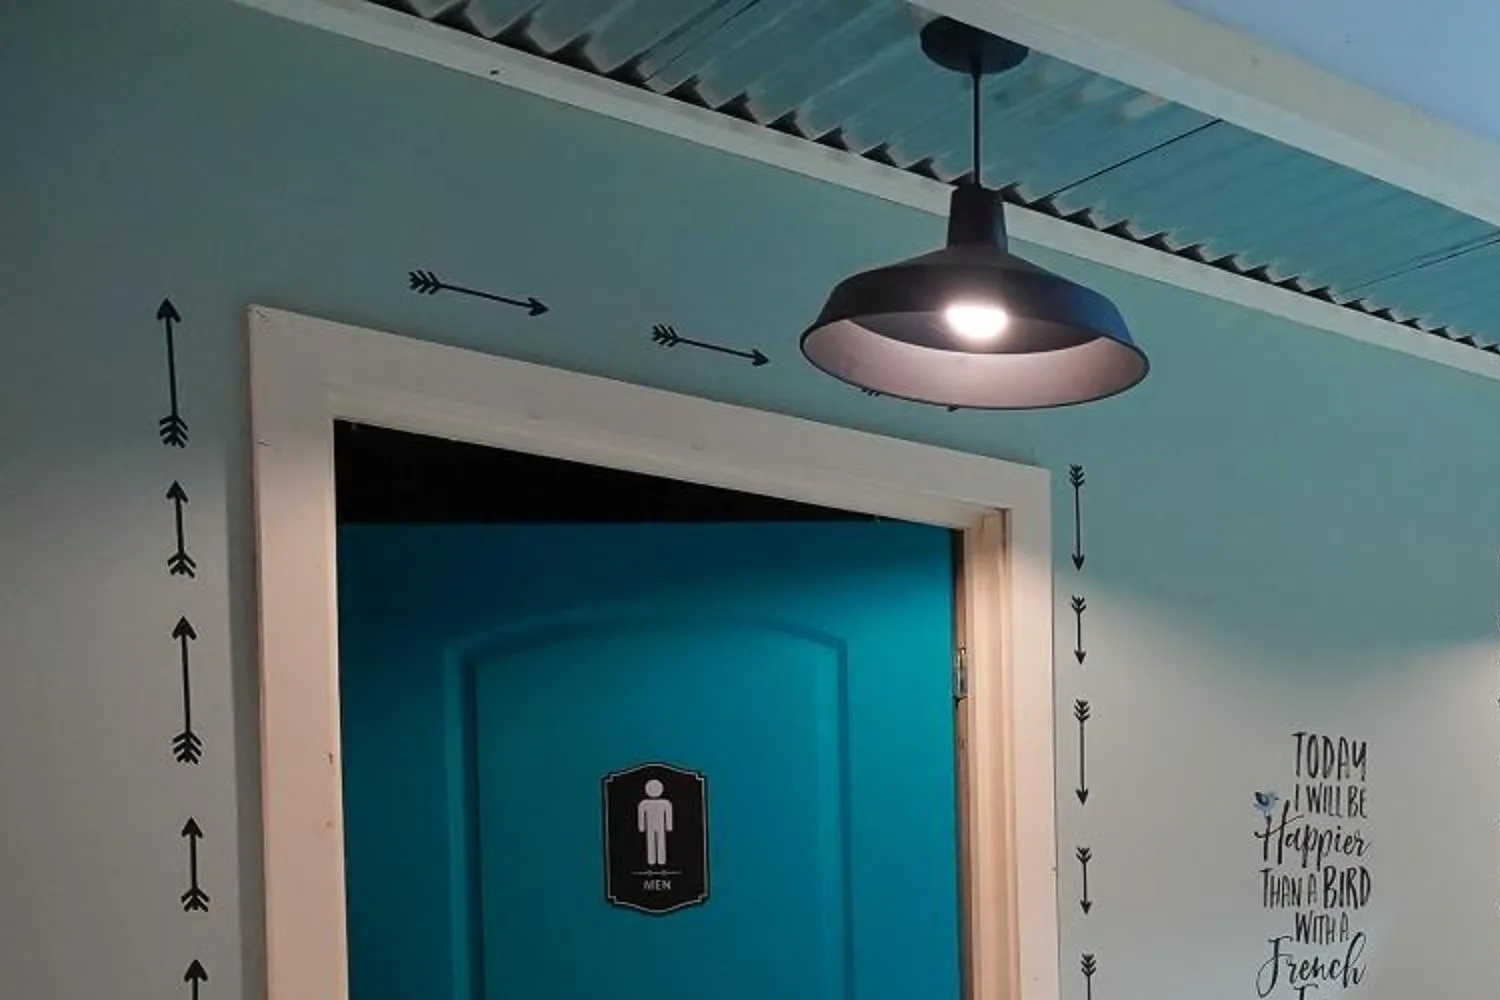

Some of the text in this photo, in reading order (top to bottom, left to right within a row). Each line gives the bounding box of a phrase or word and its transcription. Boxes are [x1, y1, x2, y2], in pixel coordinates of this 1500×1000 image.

[1291, 731, 1367, 782] TODAY
[1294, 781, 1368, 819] I WILL BE
[1253, 799, 1373, 873] Happier
[642, 878, 673, 892] MEN
[1260, 865, 1372, 910] THAN A BIRD
[1295, 910, 1350, 945] WITH A
[1256, 931, 1367, 999] French
